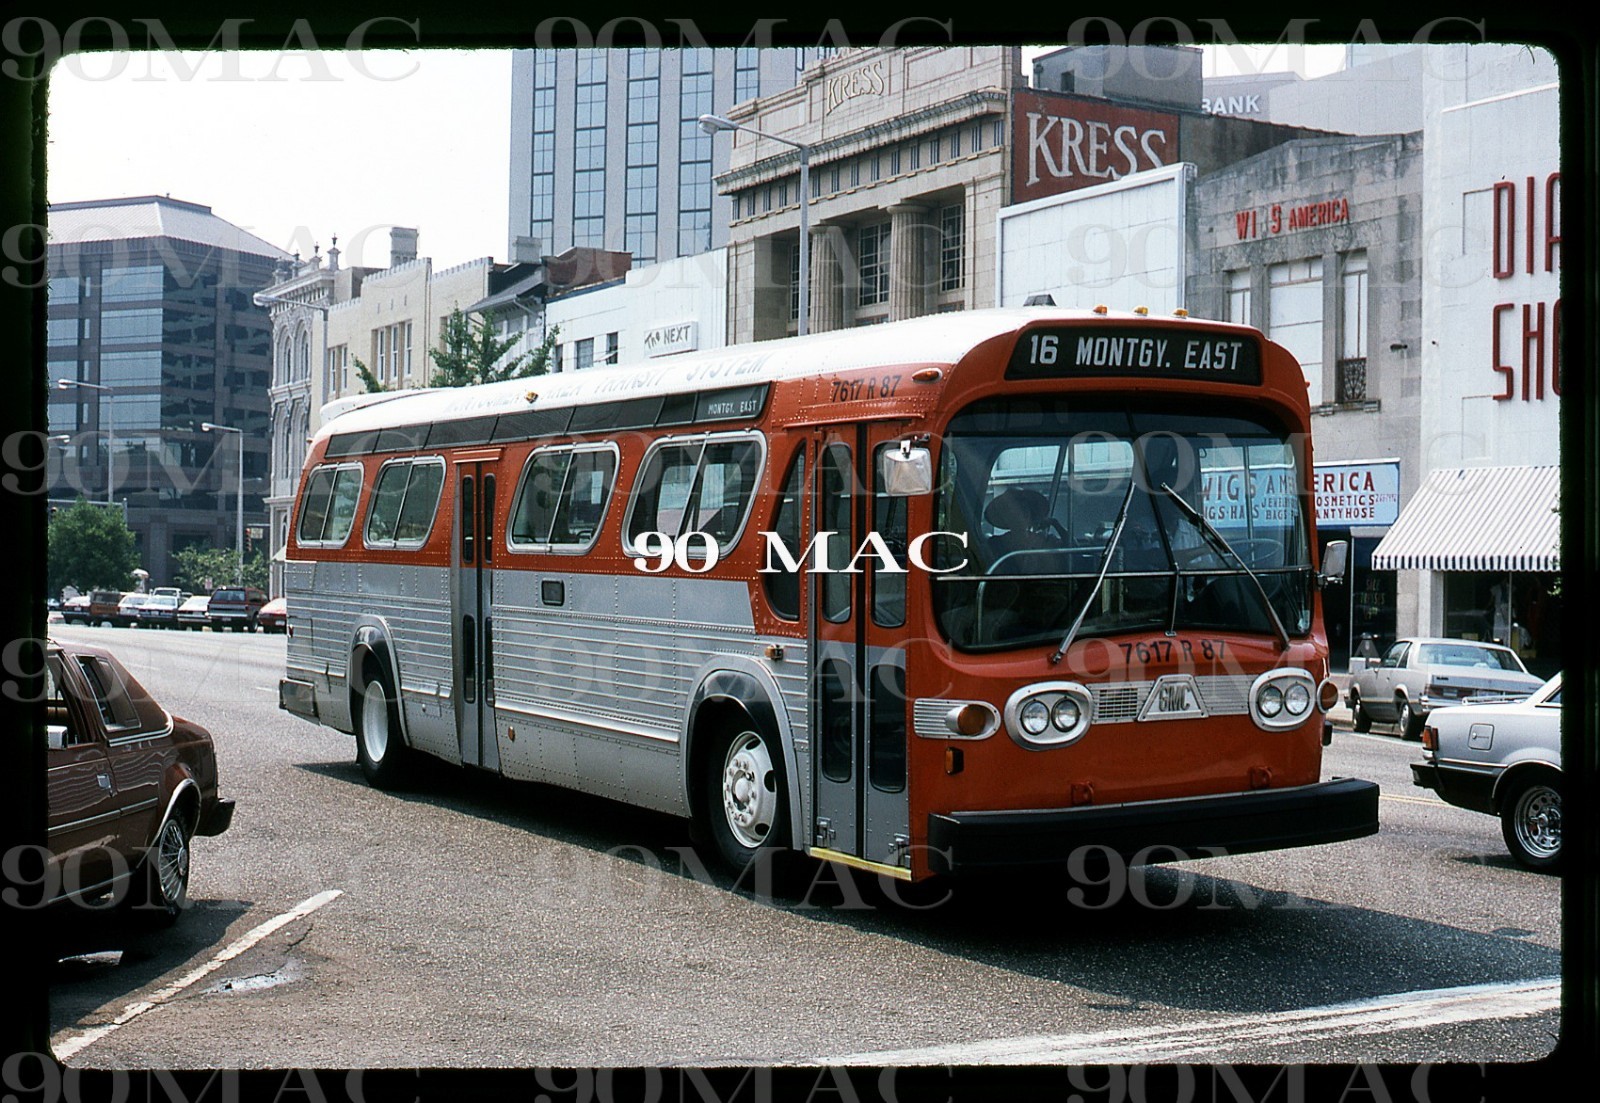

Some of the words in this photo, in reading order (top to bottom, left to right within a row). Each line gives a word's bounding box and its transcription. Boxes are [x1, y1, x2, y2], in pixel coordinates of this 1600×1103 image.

[826, 61, 884, 116] KRESS
[1201, 95, 1260, 114] BANK
[1026, 112, 1167, 187] KRESS
[1289, 198, 1350, 231] AMERICA
[663, 325, 692, 345] NEXT
[1030, 335, 1058, 364] 16
[1075, 336, 1171, 368] MONTGY.
[1184, 340, 1242, 370] EAST
[832, 379, 864, 403] 7617
[867, 378, 876, 399] R
[880, 375, 902, 398] 87
[739, 400, 758, 414] EAST
[1315, 494, 1376, 507] OSMETICS
[1119, 640, 1173, 665] 7617
[1180, 640, 1195, 662] R
[1201, 638, 1226, 661] 87
[1158, 685, 1191, 712] GMC
